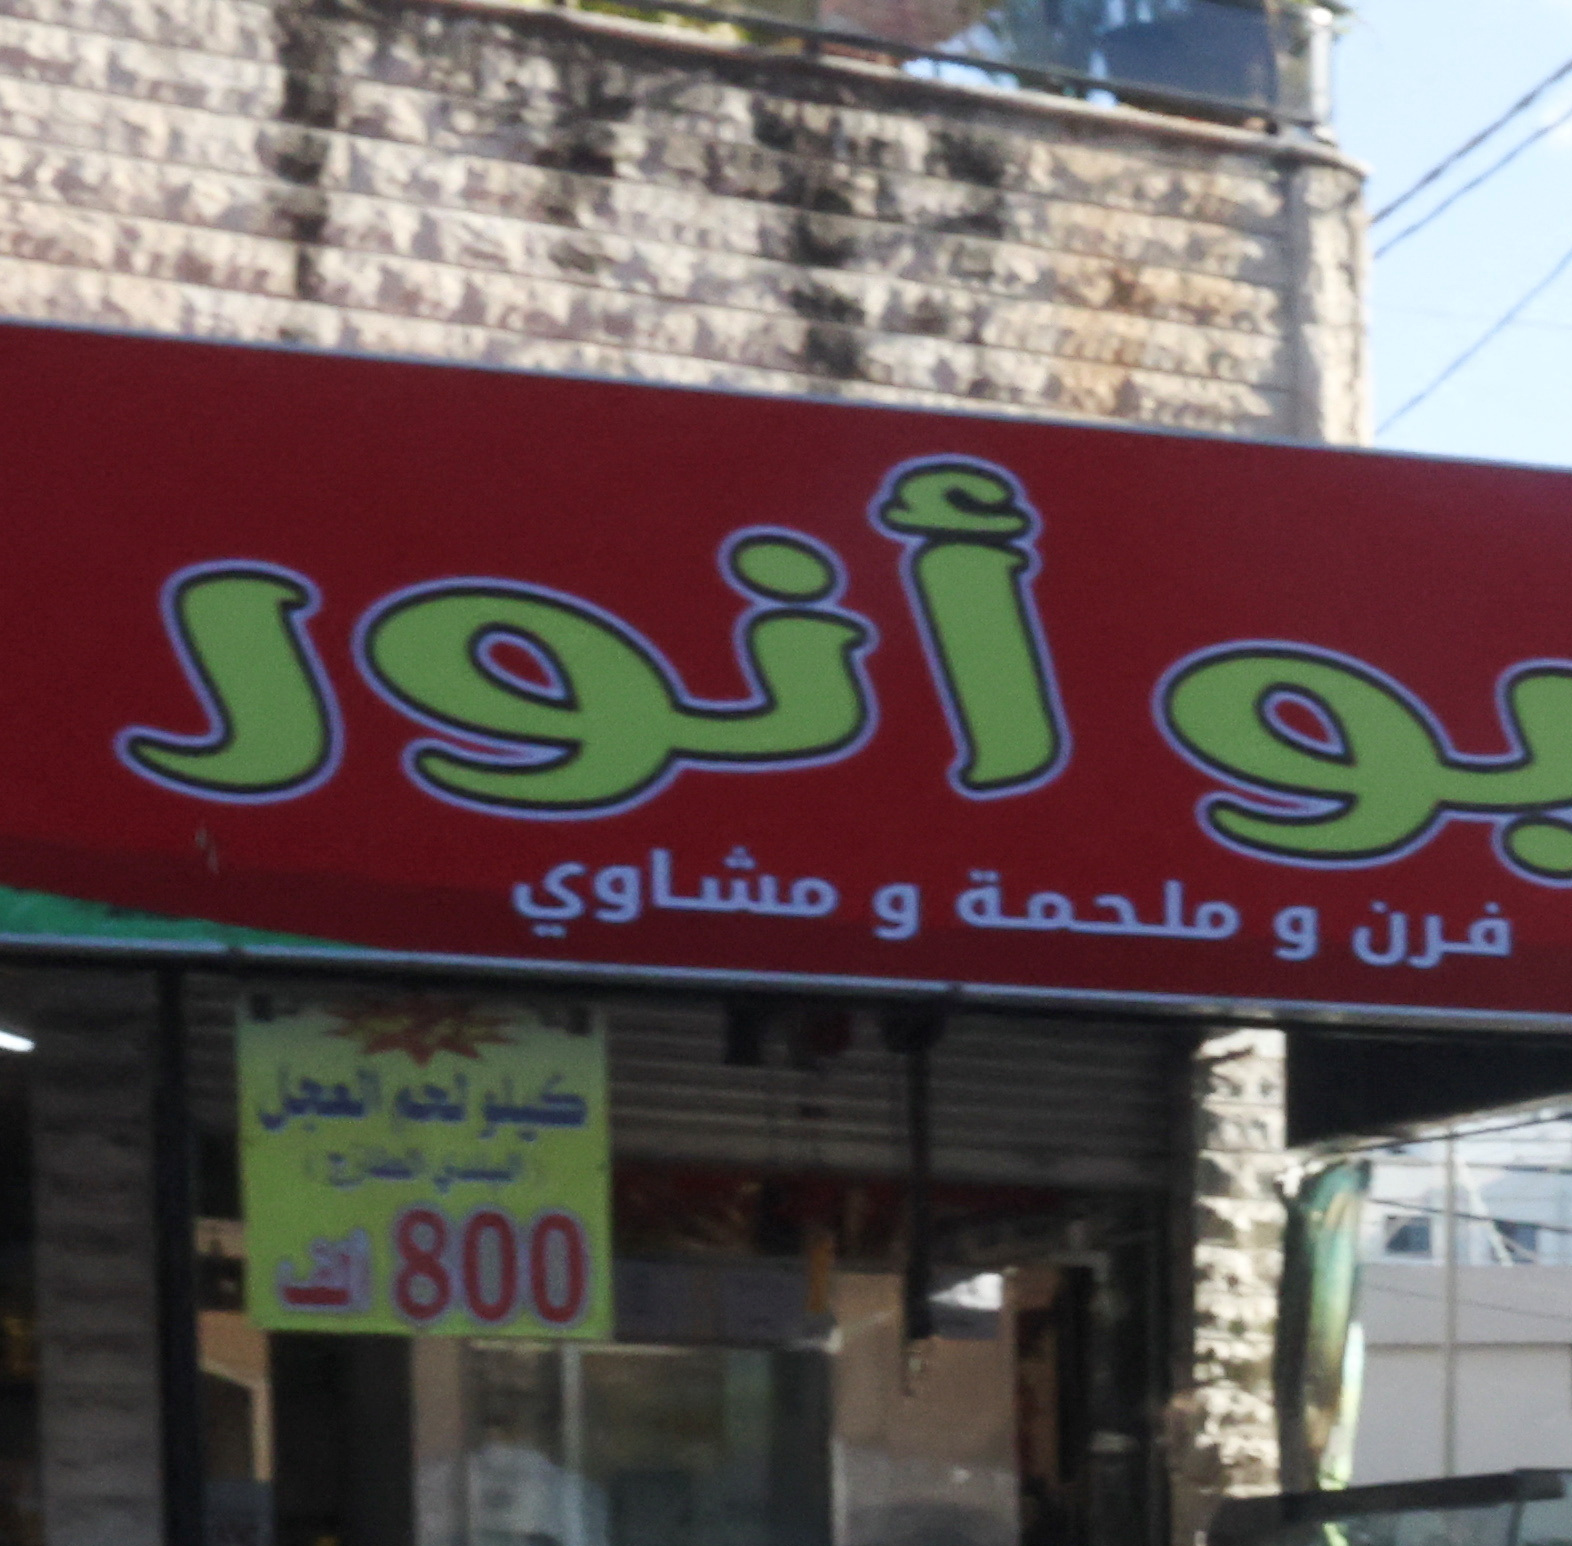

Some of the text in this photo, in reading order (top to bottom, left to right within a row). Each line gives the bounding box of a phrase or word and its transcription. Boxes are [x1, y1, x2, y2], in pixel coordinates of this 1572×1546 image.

[113, 453, 1072, 822] أنور
[510, 847, 1512, 968] فرن و ملحمة و مشاوي
[394, 1204, 588, 1326] 800
